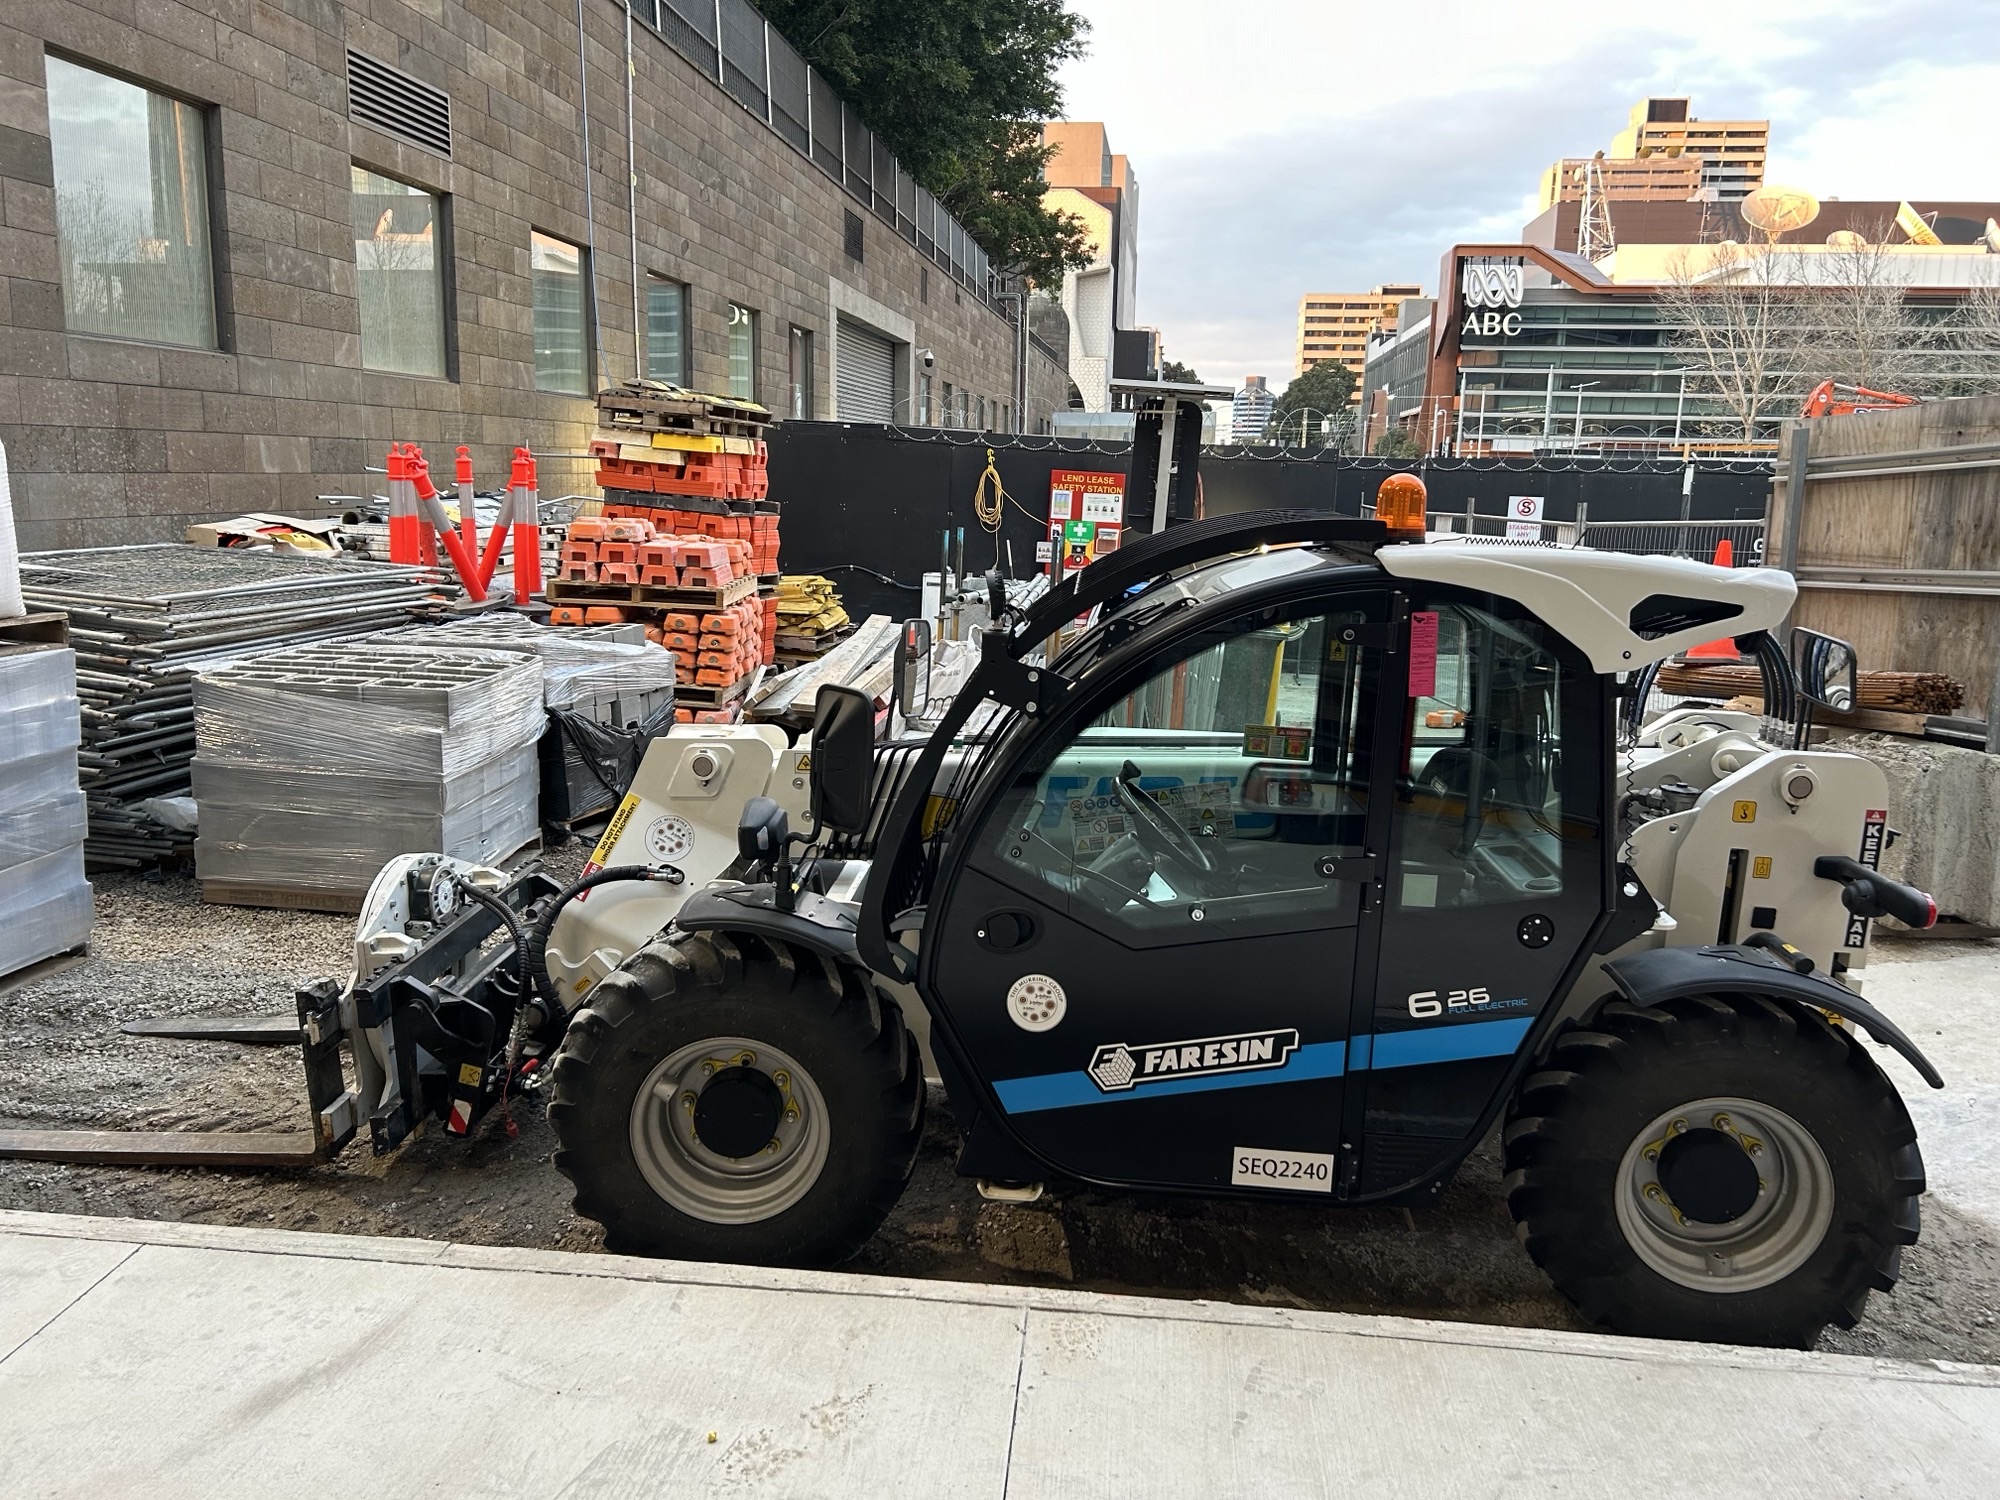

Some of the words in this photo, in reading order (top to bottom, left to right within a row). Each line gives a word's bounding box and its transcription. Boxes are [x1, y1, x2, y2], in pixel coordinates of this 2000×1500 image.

[1461, 312, 1522, 336] ABC
[1052, 482, 1086, 492] SAFETY
[1087, 485, 1123, 494] STATION
[1061, 474, 1085, 483] LEND
[1086, 475, 1115, 485] LEASE
[600, 840, 608, 851] DO
[606, 829, 615, 841] NOT
[613, 808, 626, 830] STAND
[600, 839, 616, 862] UNDER
[614, 802, 637, 841] ATTACHMENT
[1010, 986, 1019, 998] THE
[1048, 981, 1063, 1002] GROUP
[1408, 990, 1442, 1018] 6
[1447, 987, 1490, 1007] 26
[1448, 1005, 1476, 1014] FULL
[1478, 998, 1528, 1011] ELECTRIC
[1143, 1037, 1275, 1073] FARESIN
[1238, 1156, 1328, 1180] SEQ2240
